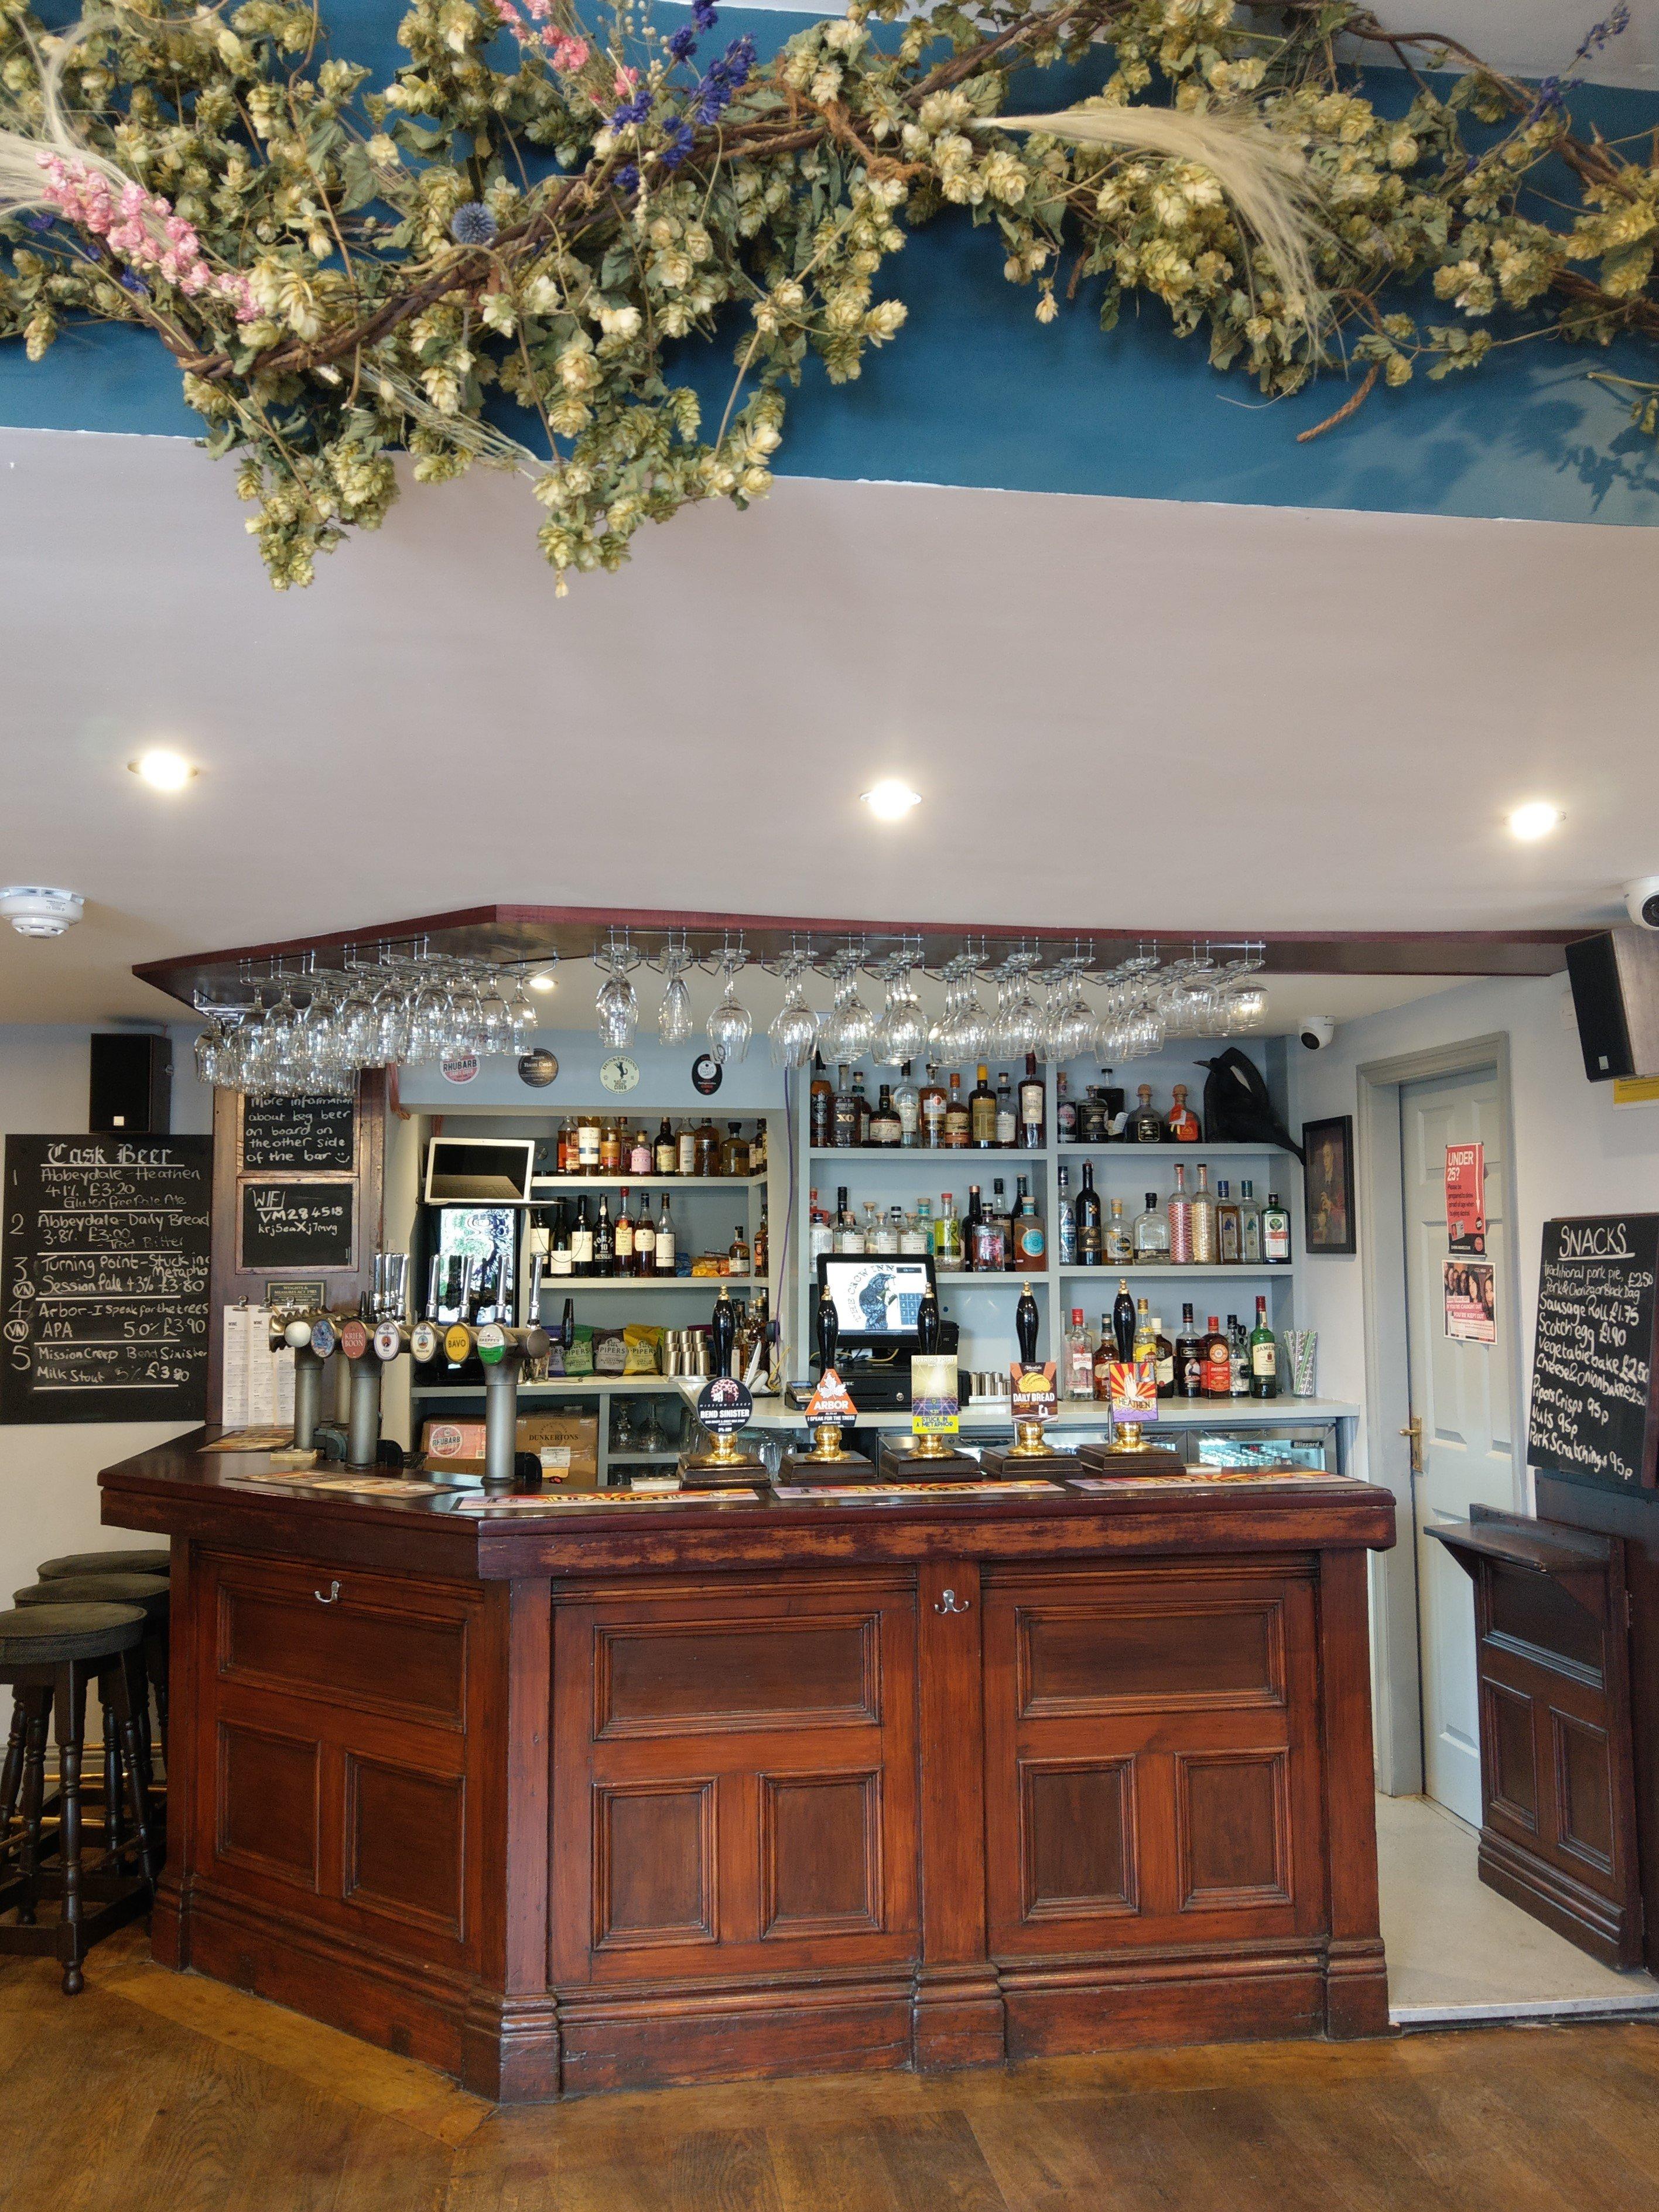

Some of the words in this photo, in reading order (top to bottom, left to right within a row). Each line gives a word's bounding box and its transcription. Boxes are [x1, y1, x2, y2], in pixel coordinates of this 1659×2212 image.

[443, 1059, 477, 1072] RHUBARB
[251, 1098, 283, 1107] More
[249, 1113, 285, 1121] about
[293, 1111, 313, 1125] keg
[321, 1110, 351, 1119] beer
[836, 1114, 855, 1122] XO
[246, 1127, 262, 1136] on
[272, 1125, 310, 1136] board
[317, 1126, 333, 1135] on
[317, 1137, 346, 1147] side
[47, 1143, 107, 1165] Cask
[117, 1143, 173, 1165] Beer
[246, 1152, 264, 1164] of
[269, 1151, 295, 1162] the
[304, 1150, 331, 1162] bar
[1448, 1151, 1474, 1166] UNDER
[13, 1169, 18, 1185] 1
[1448, 1167, 1460, 1181] 25?
[9, 1213, 24, 1235] 2
[129, 1212, 163, 1232] Daily
[169, 1211, 210, 1228] Bread
[1559, 1223, 1627, 1257] SNACKS
[12, 1256, 28, 1282] 3
[42, 1254, 95, 1279] Turning
[152, 1266, 208, 1280] Metapho
[1542, 1260, 1584, 1280] traditional
[1586, 1266, 1606, 1286] pork
[39, 1275, 97, 1296] Session
[8, 1300, 29, 1318] 4
[1539, 1291, 1586, 1326] Sausage
[1585, 1294, 1609, 1321] Roll
[42, 1321, 73, 1338] APA
[1539, 1312, 1572, 1336] Scotch
[1574, 1325, 1595, 1357] egg
[448, 1339, 466, 1348] BAVO
[1256, 1345, 1275, 1353] JAMES
[1539, 1336, 1591, 1365] Vegetable
[11, 1345, 31, 1370] 5
[39, 1347, 83, 1360] Mission
[84, 1348, 118, 1364] Creep
[565, 1348, 590, 1356] PIPERS
[37, 1366, 67, 1380] Milk
[70, 1368, 104, 1383] Stout
[813, 1400, 849, 1410] ARBOR
[1012, 1393, 1031, 1402] DAILY
[1031, 1392, 1055, 1402] BREAD
[1118, 1397, 1151, 1408] HEATHEN
[700, 1410, 719, 1418] BEND
[719, 1408, 750, 1418] SINISTER
[1587, 1397, 1609, 1425] 95p
[1558, 1413, 1578, 1440] 95p
[432, 1436, 461, 1447] RHUBARB
[1610, 1451, 1633, 1481] 95p
